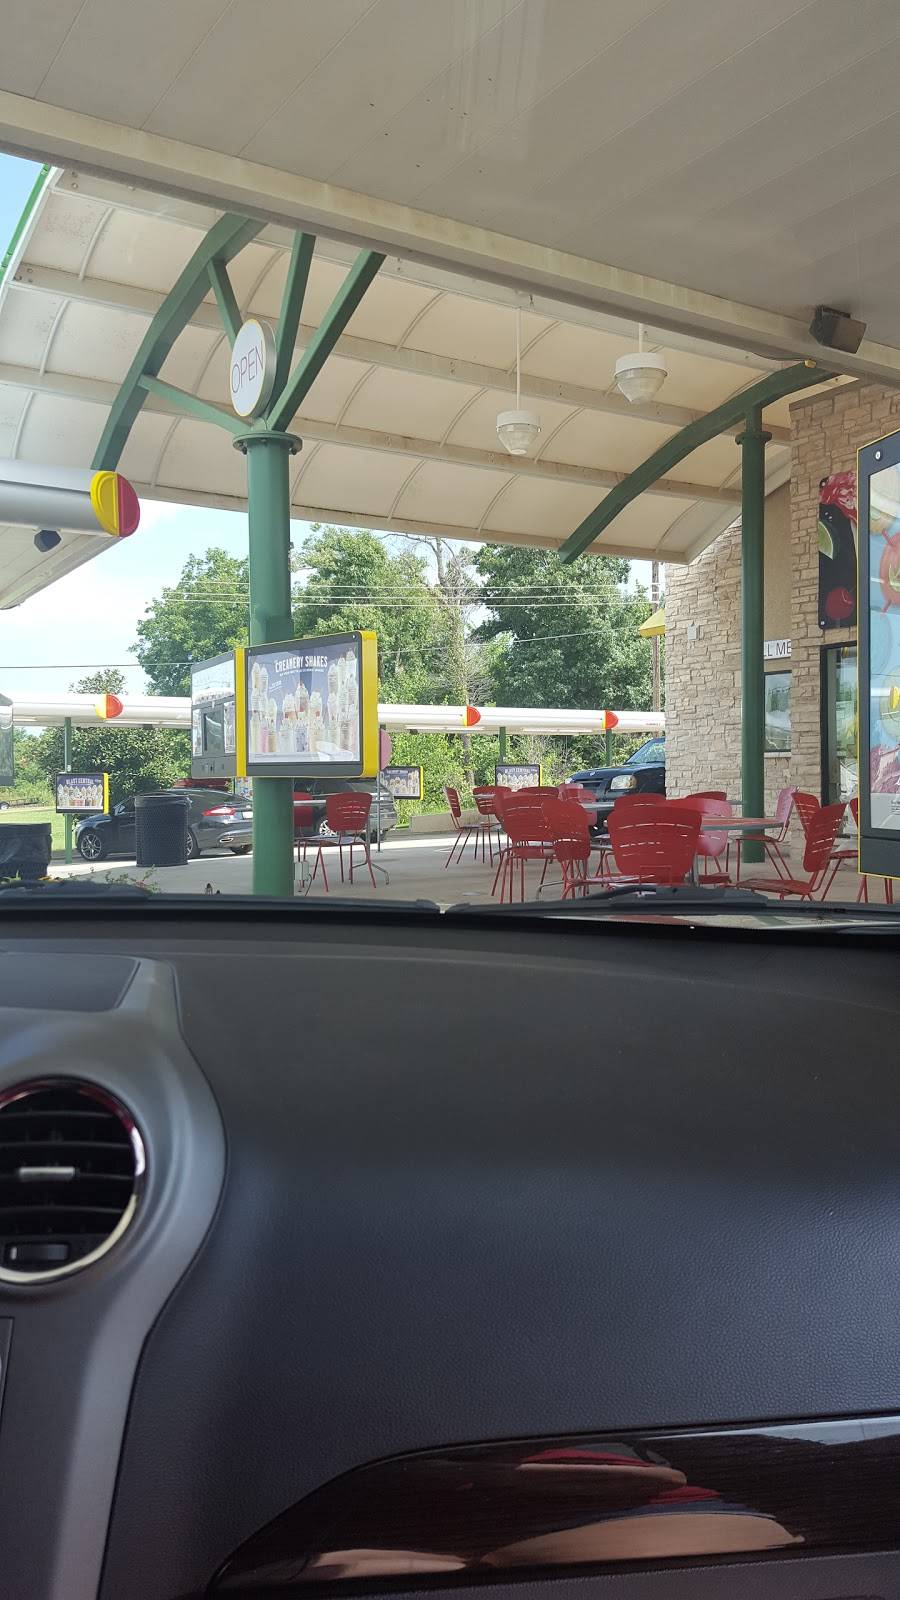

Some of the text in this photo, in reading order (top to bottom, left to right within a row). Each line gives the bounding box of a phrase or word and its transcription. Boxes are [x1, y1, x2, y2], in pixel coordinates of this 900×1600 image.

[231, 339, 264, 393] OPEN
[275, 656, 304, 673] CREAMERY
[304, 655, 328, 668] SHAKES
